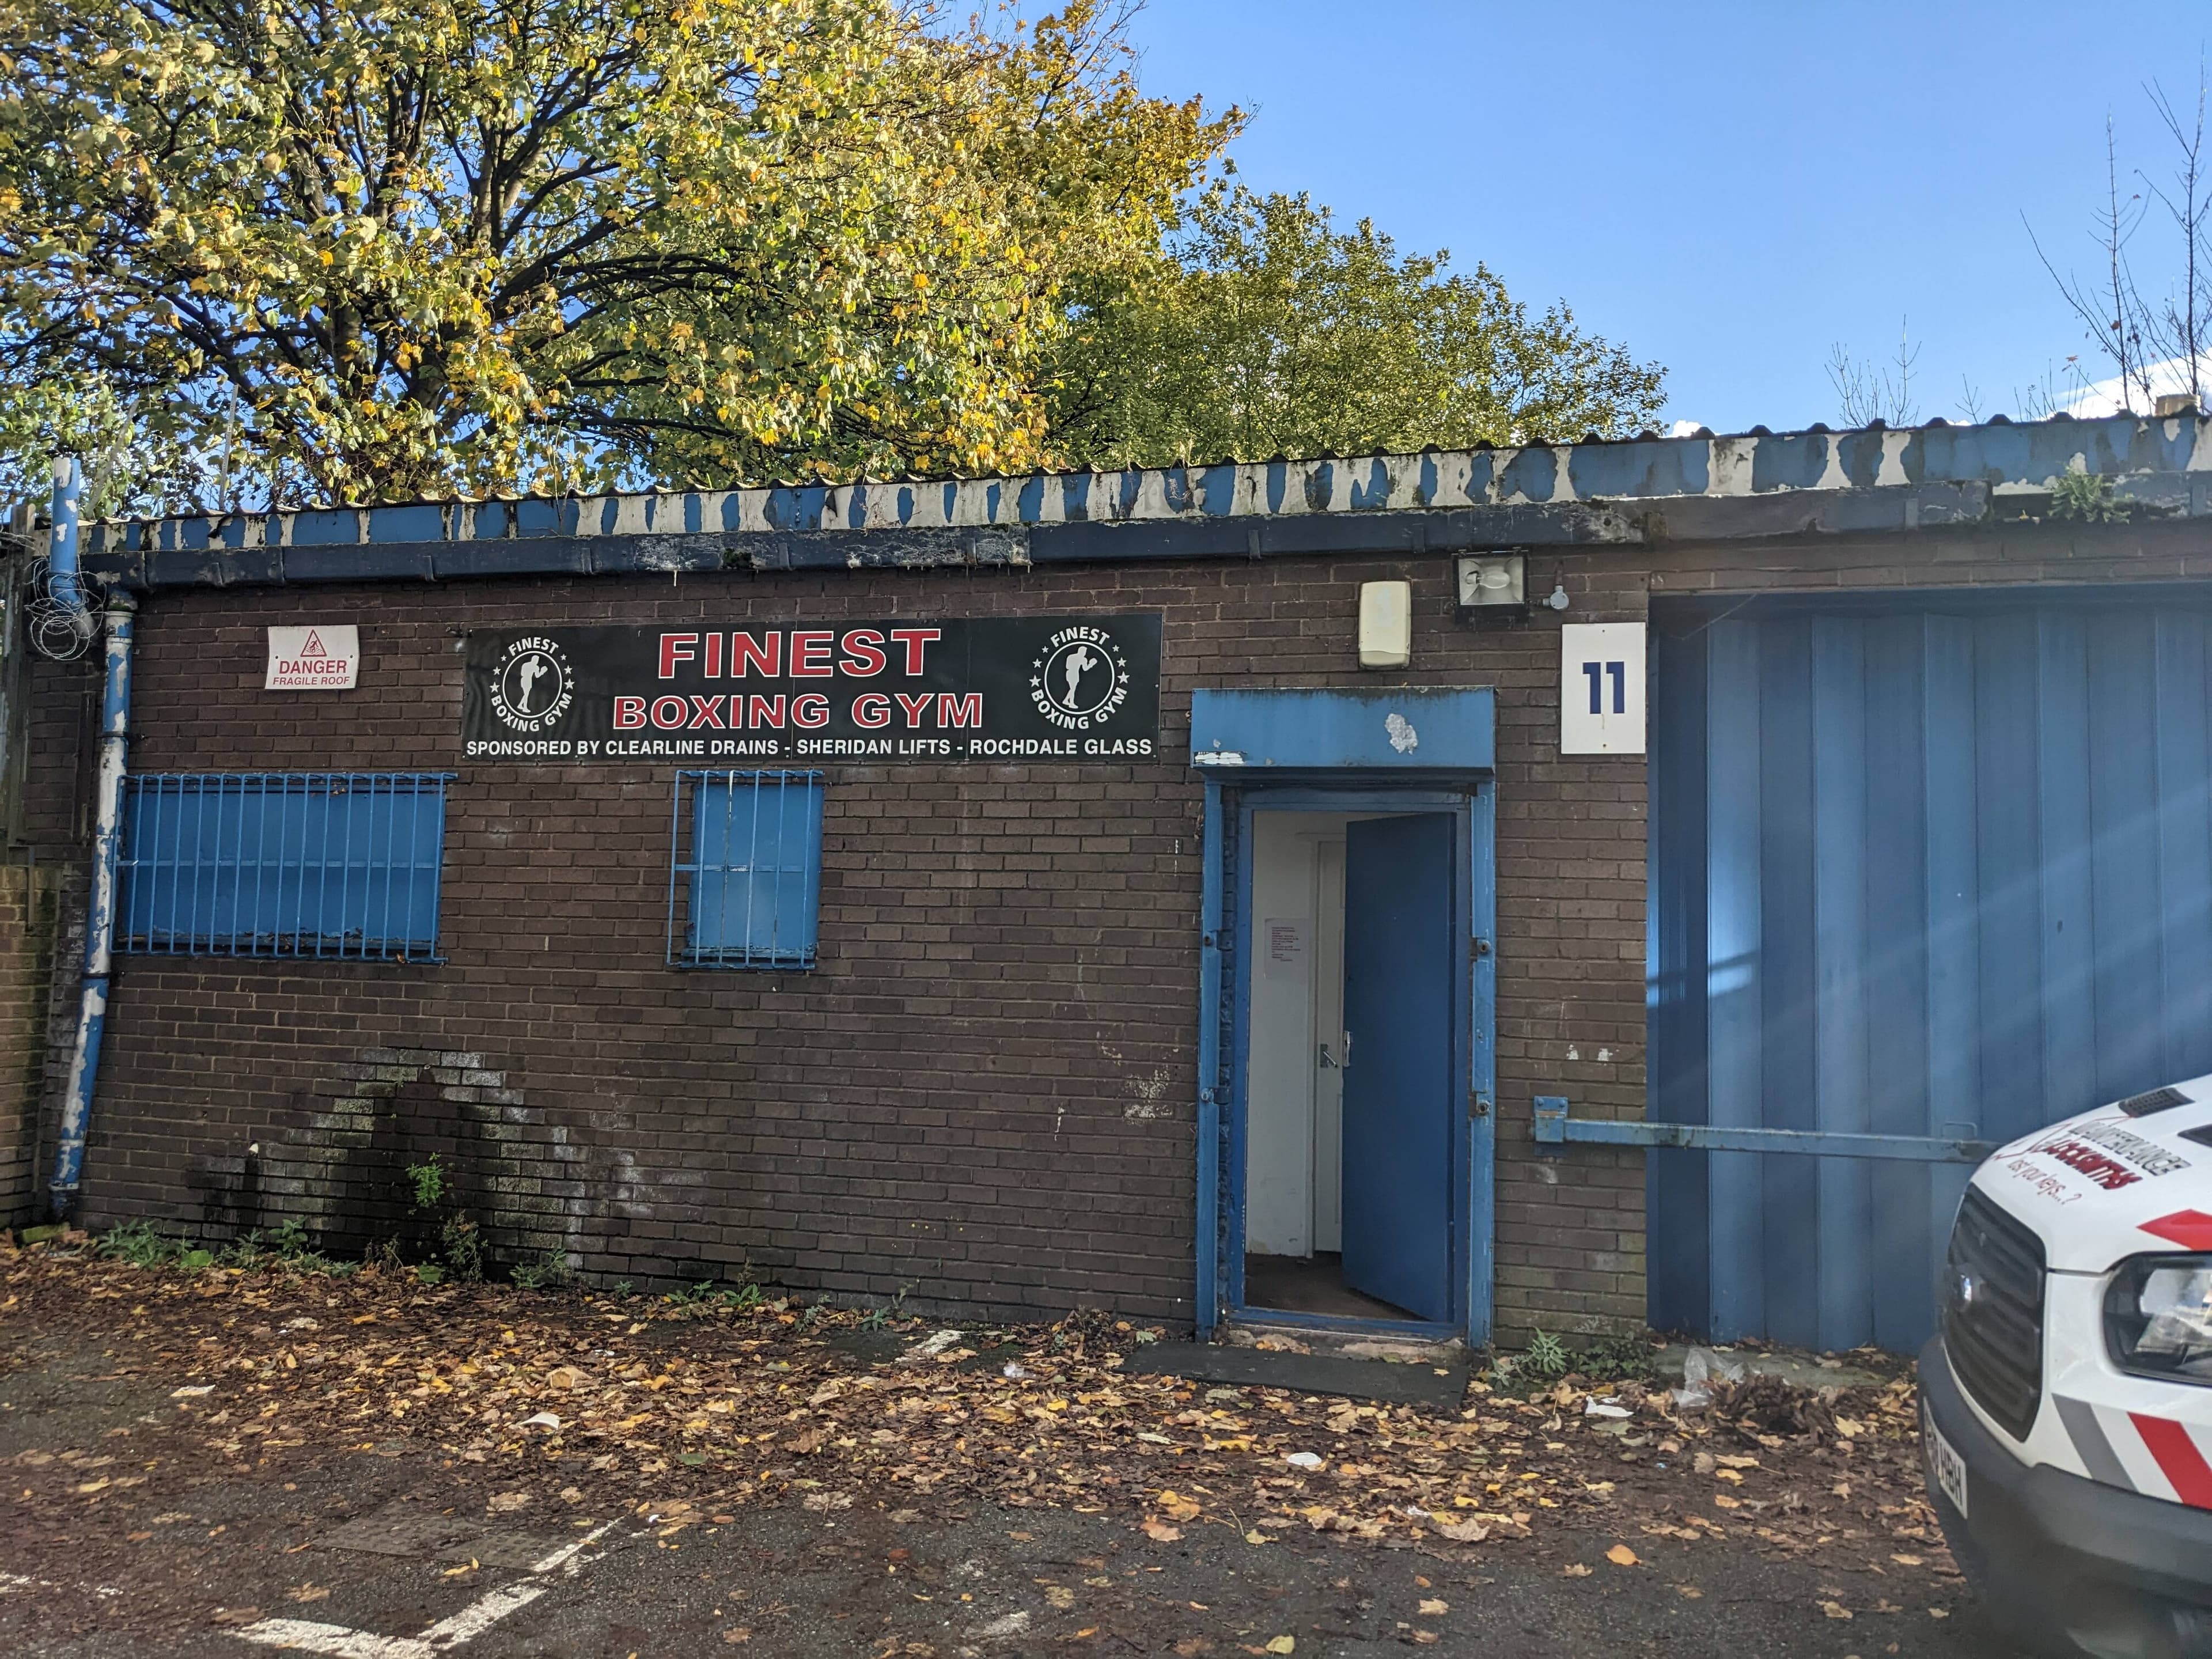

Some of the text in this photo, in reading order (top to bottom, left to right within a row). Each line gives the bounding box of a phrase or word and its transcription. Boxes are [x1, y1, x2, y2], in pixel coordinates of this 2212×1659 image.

[508, 637, 559, 657] FINEST
[1050, 626, 1110, 647] FINEST
[279, 660, 347, 674] DANGER
[658, 628, 941, 679] FINEST
[273, 676, 350, 685] FRAGILE ROOF
[1582, 661, 1625, 714] 11
[490, 692, 573, 732] BOXING GYM
[613, 693, 983, 730] BOXING GYM
[1032, 687, 1127, 729] BOXING GYM
[467, 740, 571, 755] SPONSORED
[578, 740, 600, 755] BY
[605, 740, 706, 755] CLEARLINE
[710, 740, 778, 755] DRAINS
[797, 739, 892, 755] SHERIDAN
[899, 739, 950, 754] LIFTS
[969, 739, 1077, 754] ROCHDALE
[1084, 738, 1152, 755] GLASS
